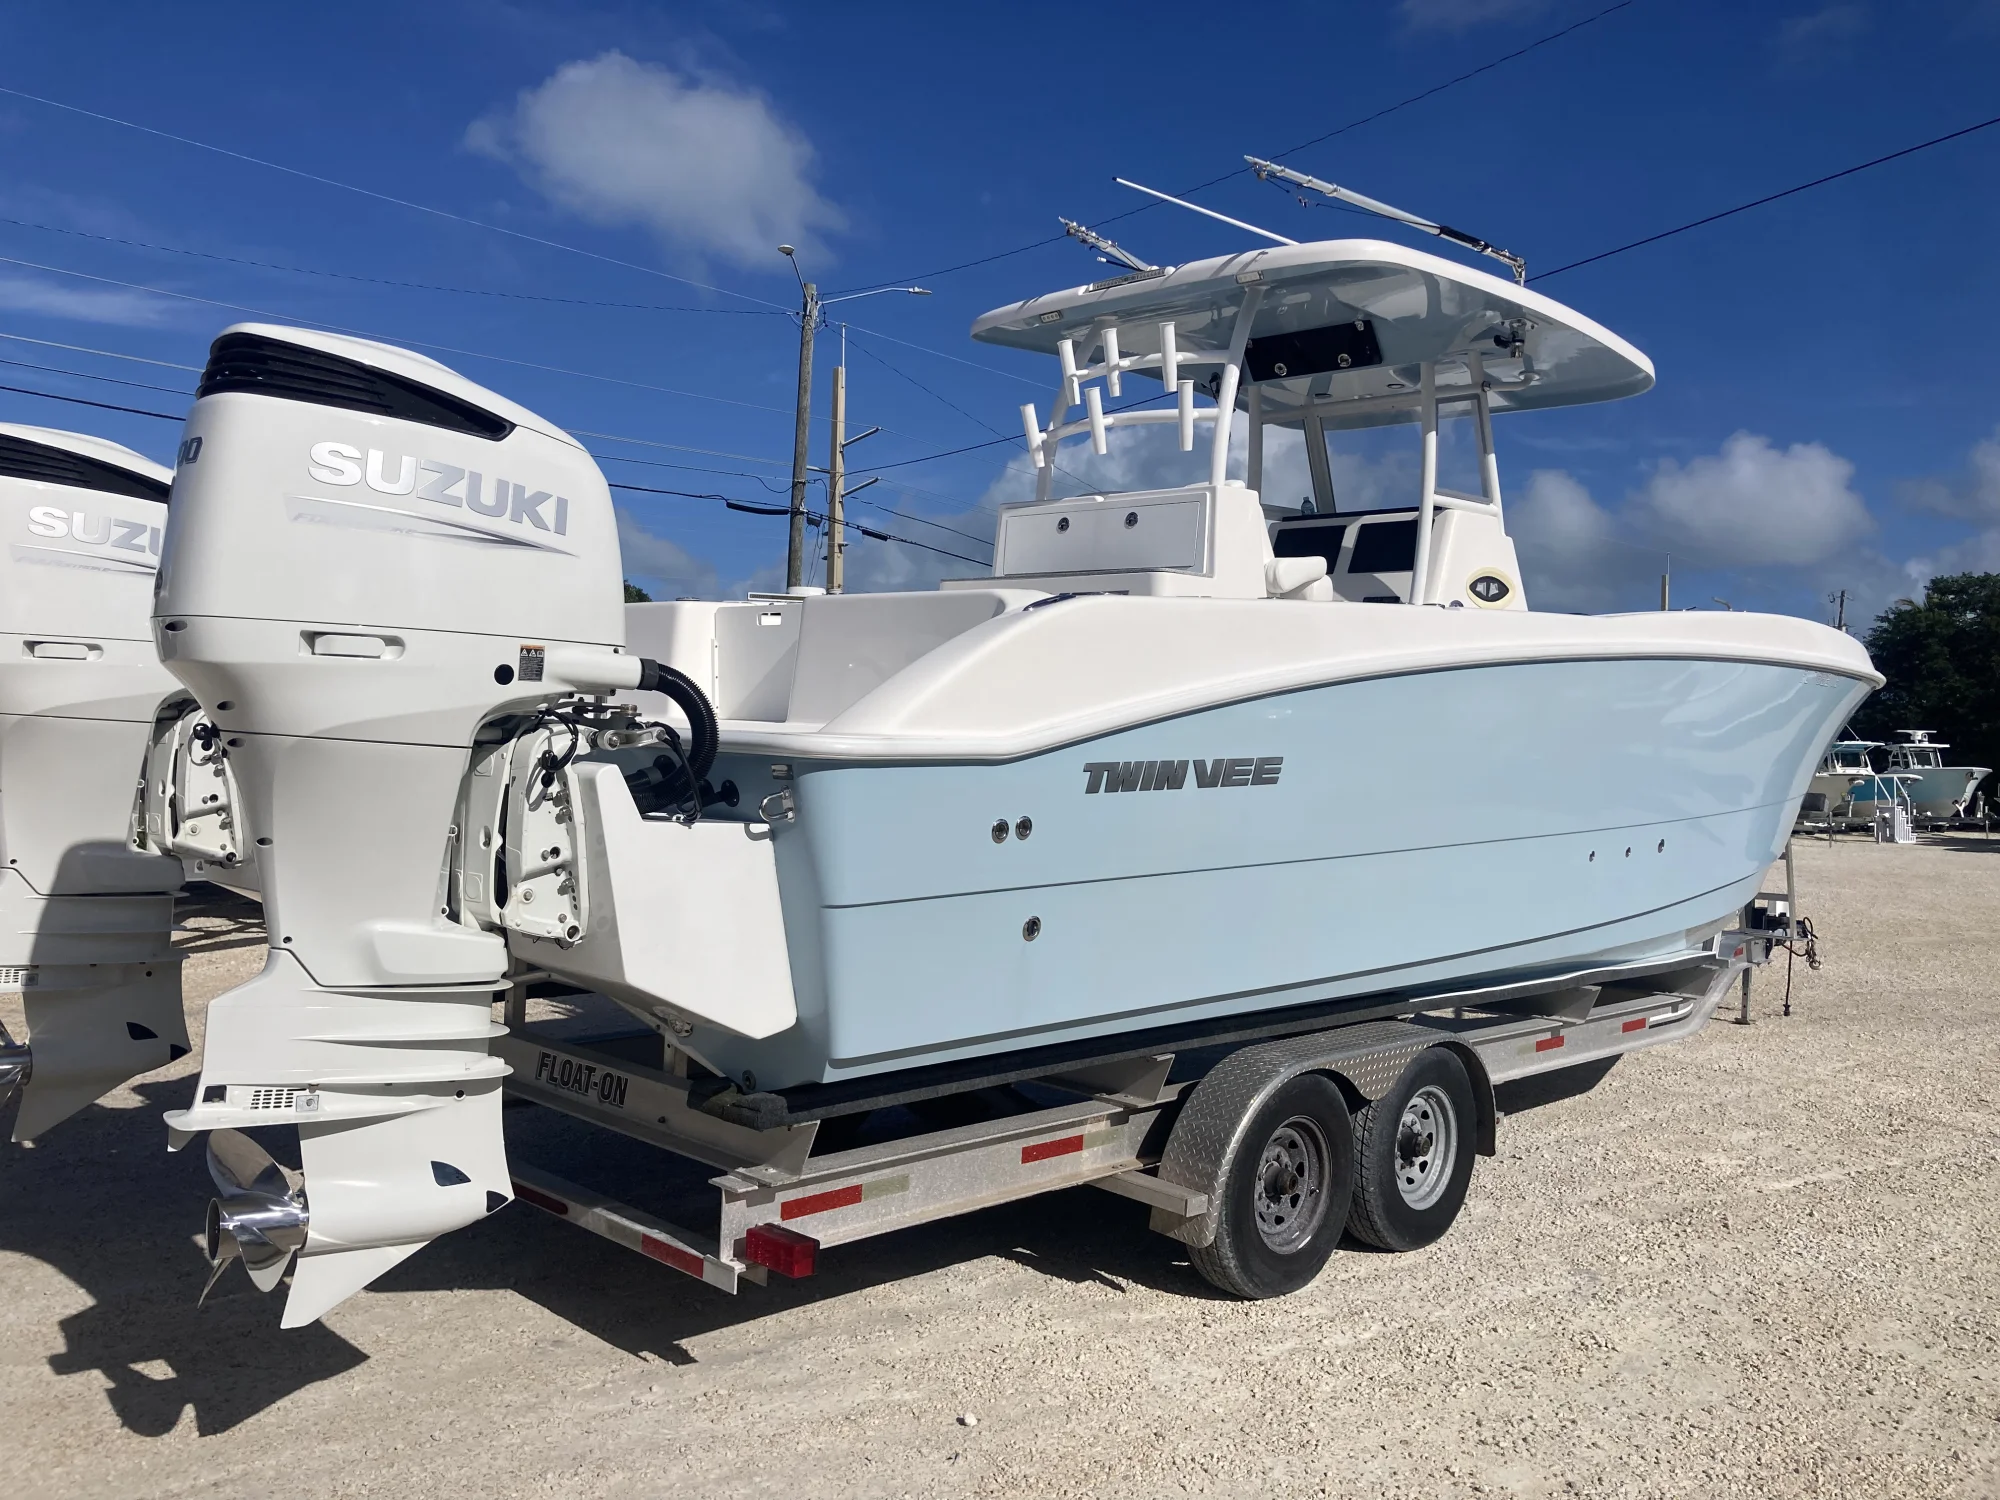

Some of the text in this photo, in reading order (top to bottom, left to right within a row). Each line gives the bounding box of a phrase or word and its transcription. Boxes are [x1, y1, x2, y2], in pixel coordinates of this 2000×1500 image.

[308, 441, 568, 536] SUZUKI
[1083, 757, 1284, 794] TWIN VEE
[536, 1049, 629, 1109] FLOAT-ON
